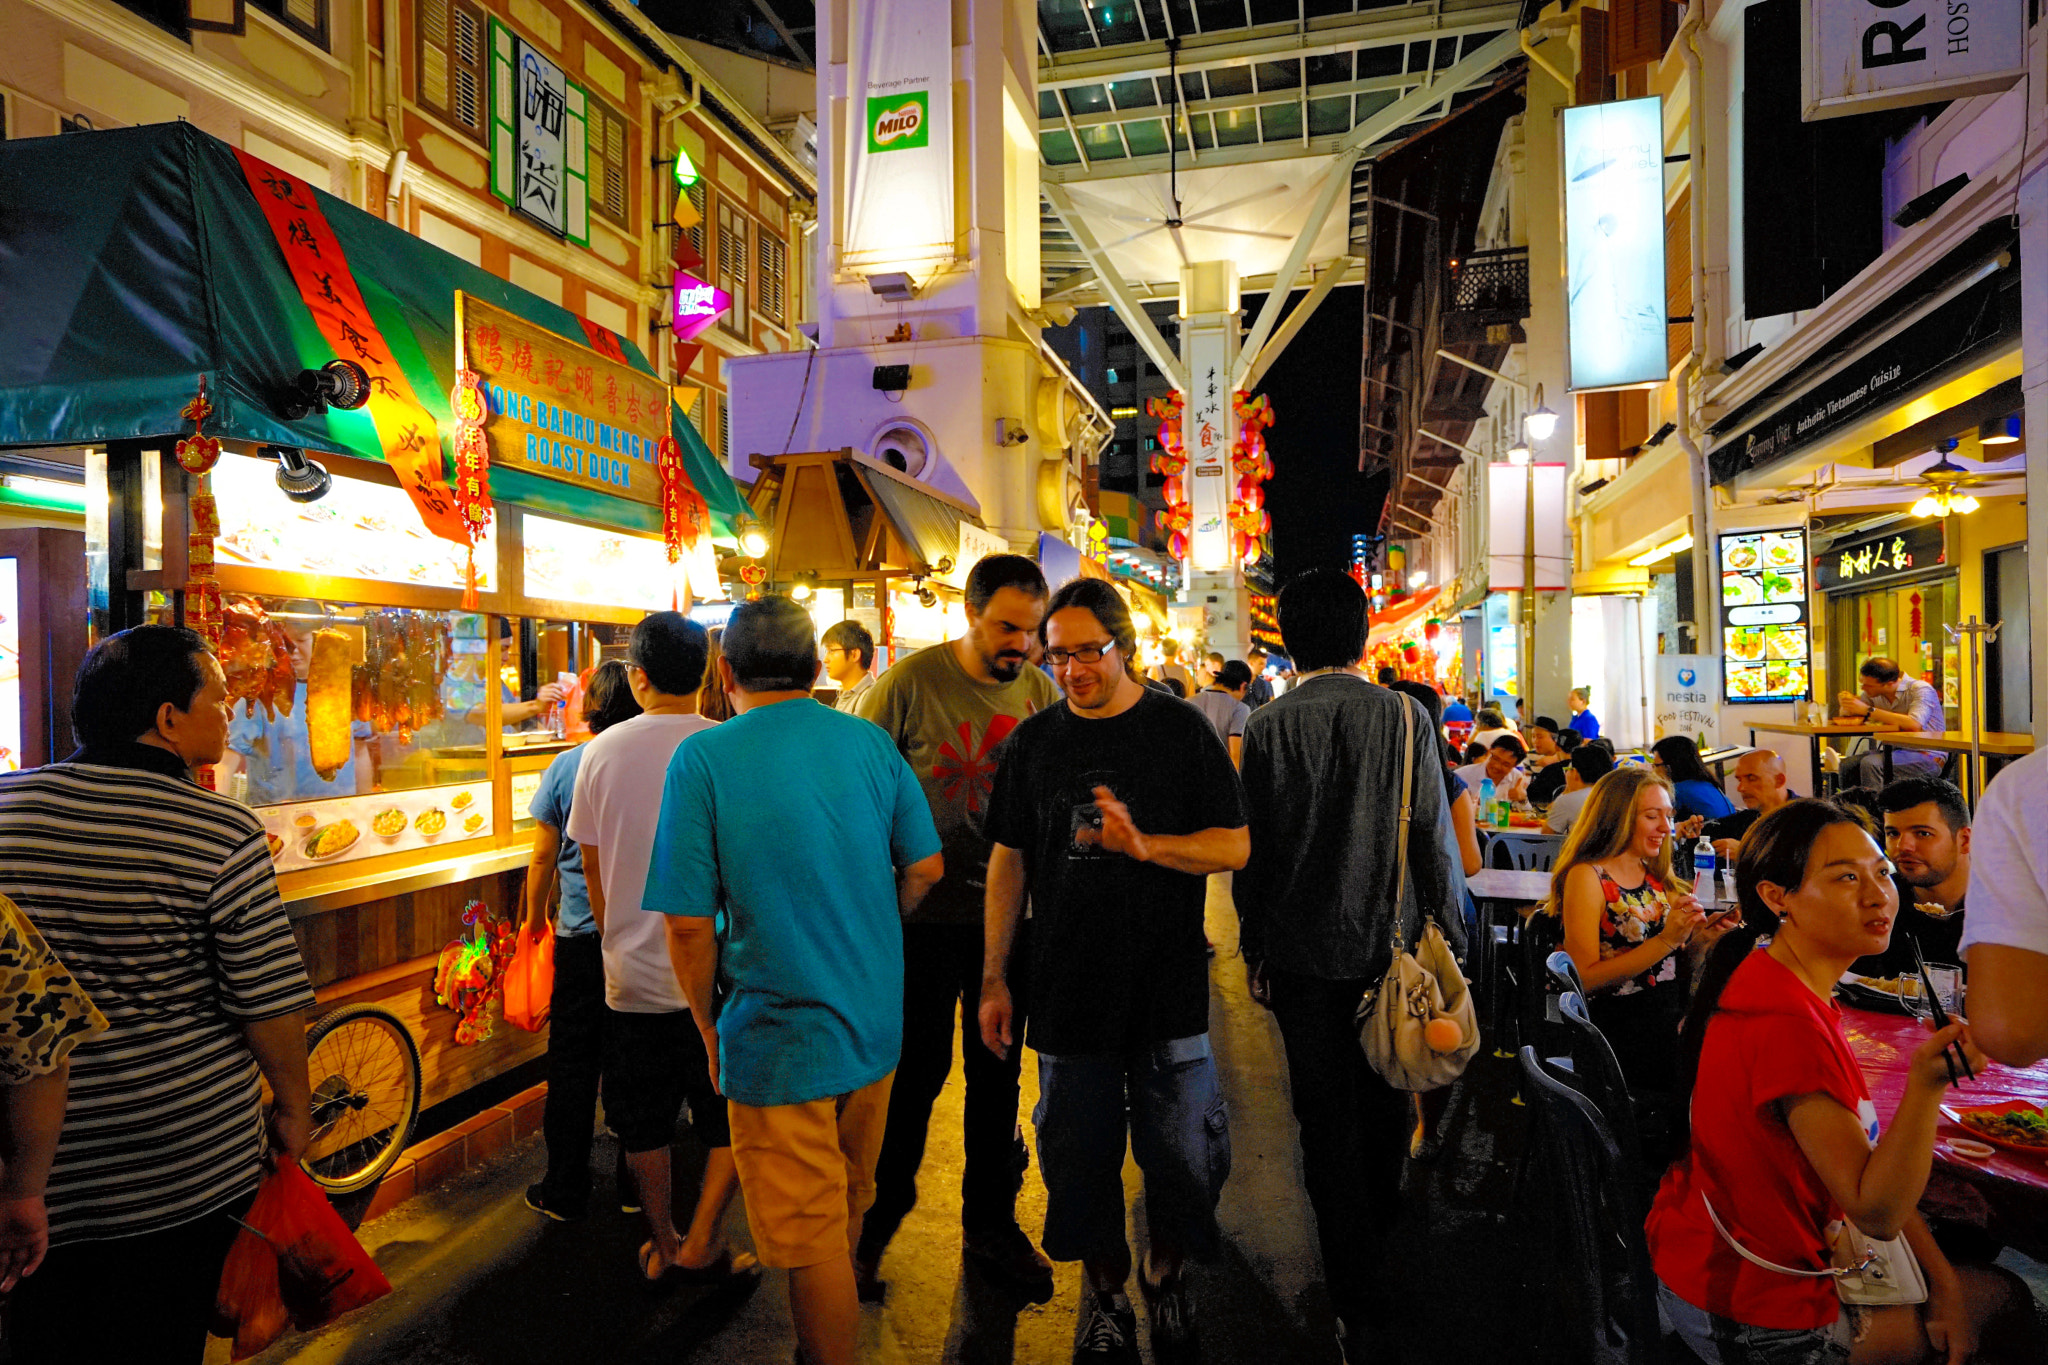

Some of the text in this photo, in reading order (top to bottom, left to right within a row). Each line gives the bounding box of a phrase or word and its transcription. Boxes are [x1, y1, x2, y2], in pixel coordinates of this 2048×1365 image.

[1862, 0, 1926, 69] R
[867, 76, 930, 89] Beverage Partner
[878, 114, 918, 136] MILO
[1870, 364, 1901, 392] Cuisine
[477, 380, 532, 424] IONG
[536, 400, 595, 445] BAHRU
[599, 422, 639, 459] MENG
[526, 432, 632, 488] ROAST DUCK
[1667, 690, 1707, 703] nestia
[1657, 710, 1716, 728] FOOD FESTIVAL
[1680, 724, 1693, 732] 2016
